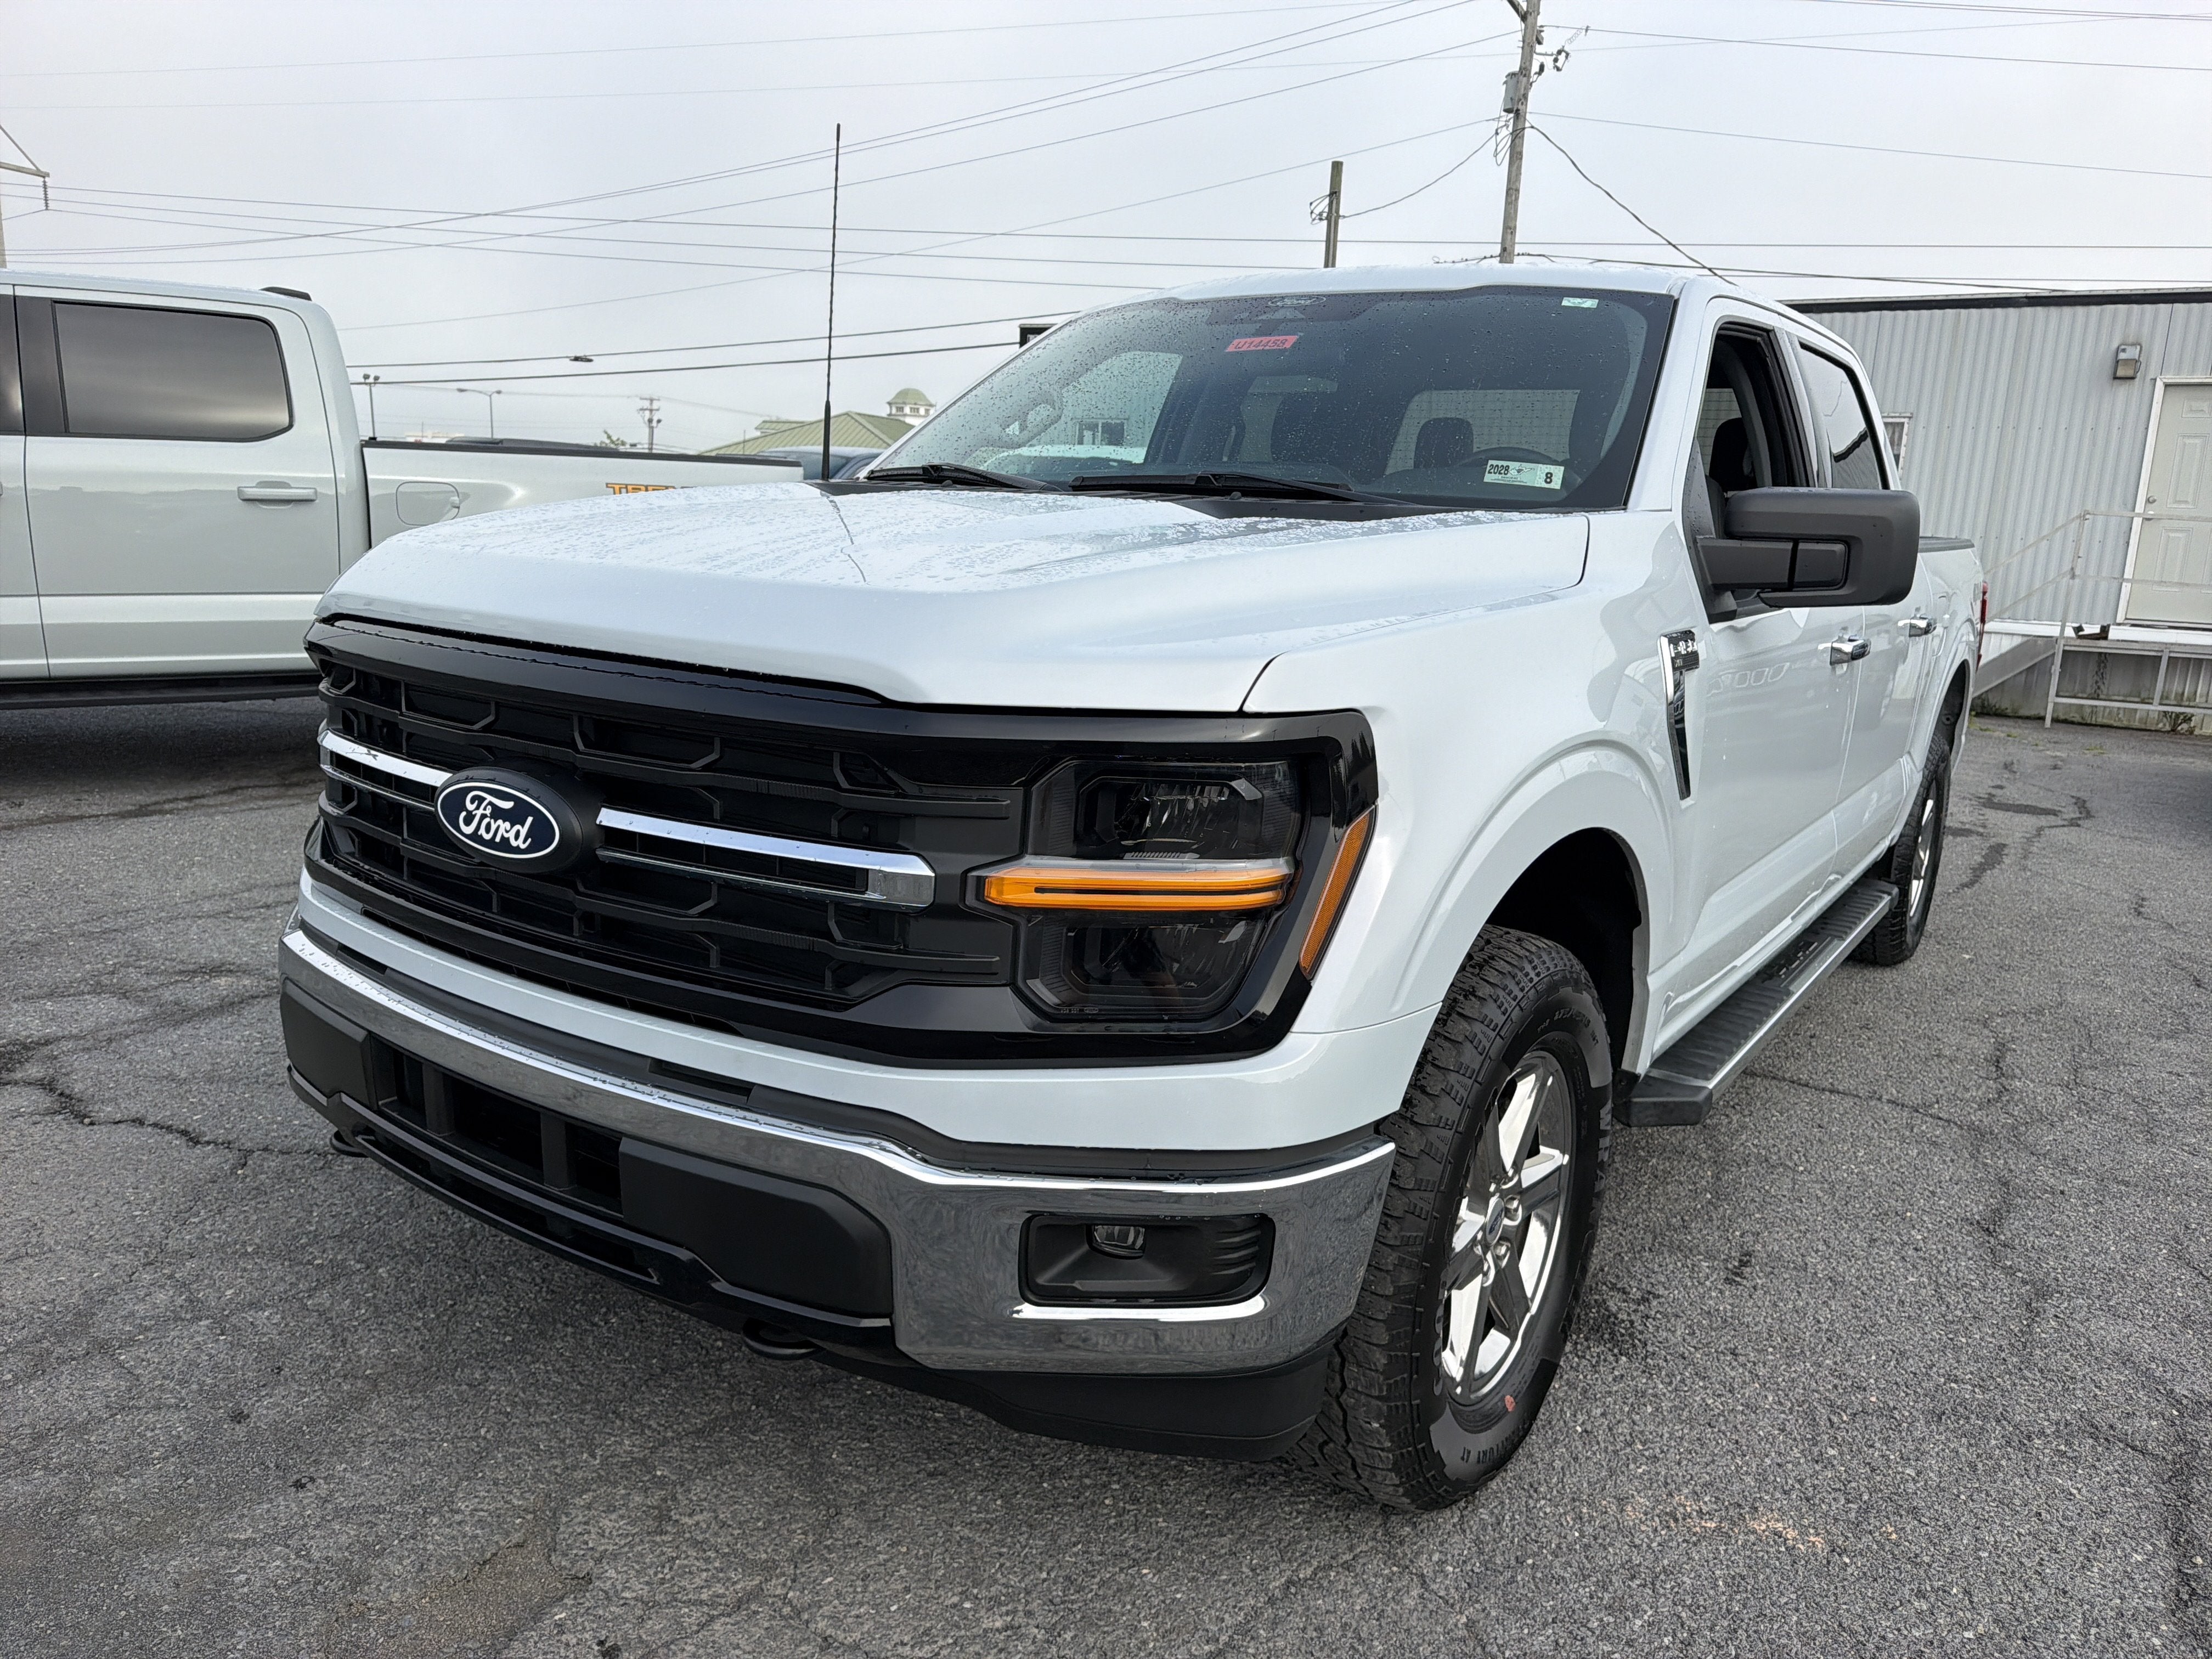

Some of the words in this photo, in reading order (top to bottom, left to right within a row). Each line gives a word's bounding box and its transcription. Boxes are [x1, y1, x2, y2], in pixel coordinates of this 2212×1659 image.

[1487, 464, 1510, 476] 2028
[1543, 471, 1554, 484] 8
[458, 791, 534, 850] Ford
